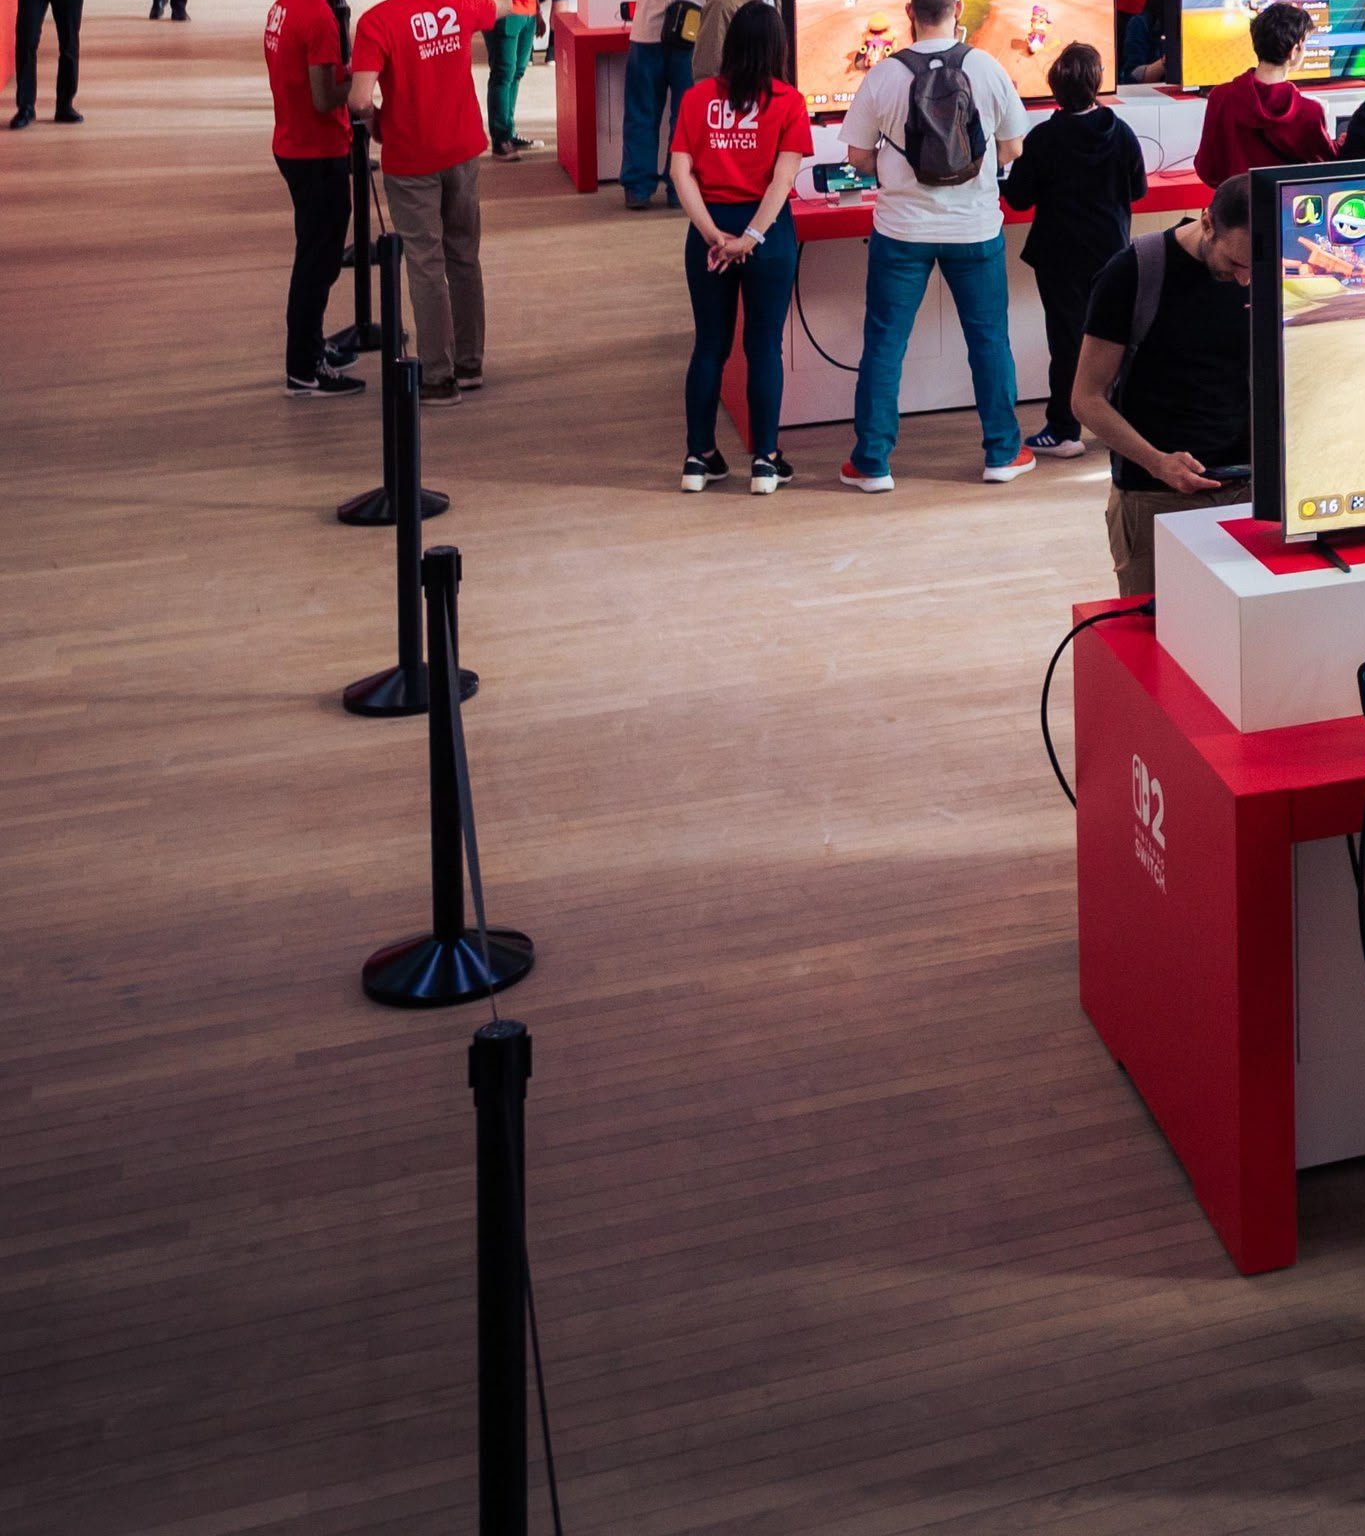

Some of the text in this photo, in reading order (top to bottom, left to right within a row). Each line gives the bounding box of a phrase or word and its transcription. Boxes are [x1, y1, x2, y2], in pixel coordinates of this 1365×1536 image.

[437, 6, 461, 36] 2
[419, 41, 461, 60] SWITCH
[738, 100, 760, 130] 2
[709, 138, 757, 149] SWITCH
[1319, 498, 1338, 514] 16
[1150, 777, 1166, 851] 2
